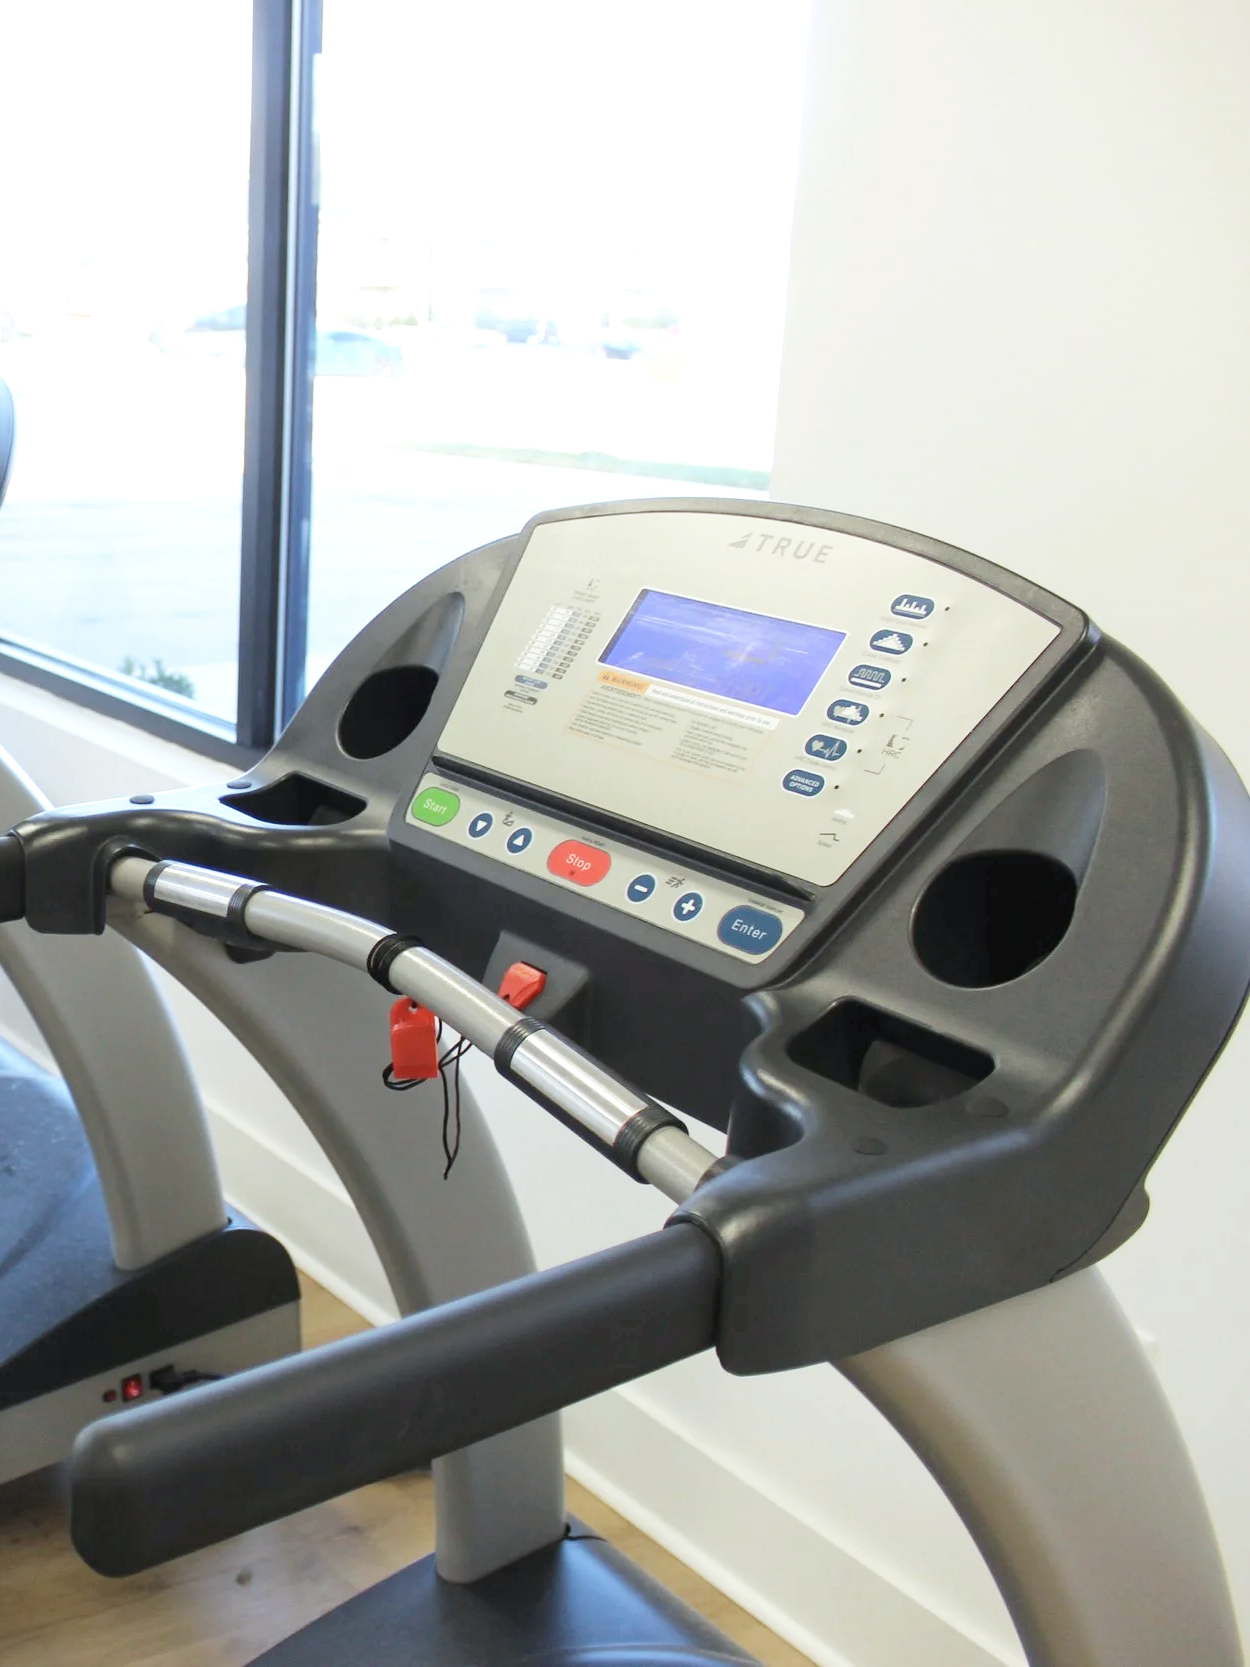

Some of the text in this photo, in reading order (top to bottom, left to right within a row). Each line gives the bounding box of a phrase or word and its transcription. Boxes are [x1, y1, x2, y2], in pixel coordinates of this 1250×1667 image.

[756, 533, 834, 564] TRUE
[789, 781, 814, 793] OPTIONS
[790, 774, 821, 788] ADVANCED
[423, 798, 447, 815] Start
[565, 853, 592, 872] Stop
[731, 919, 768, 941] Enter
